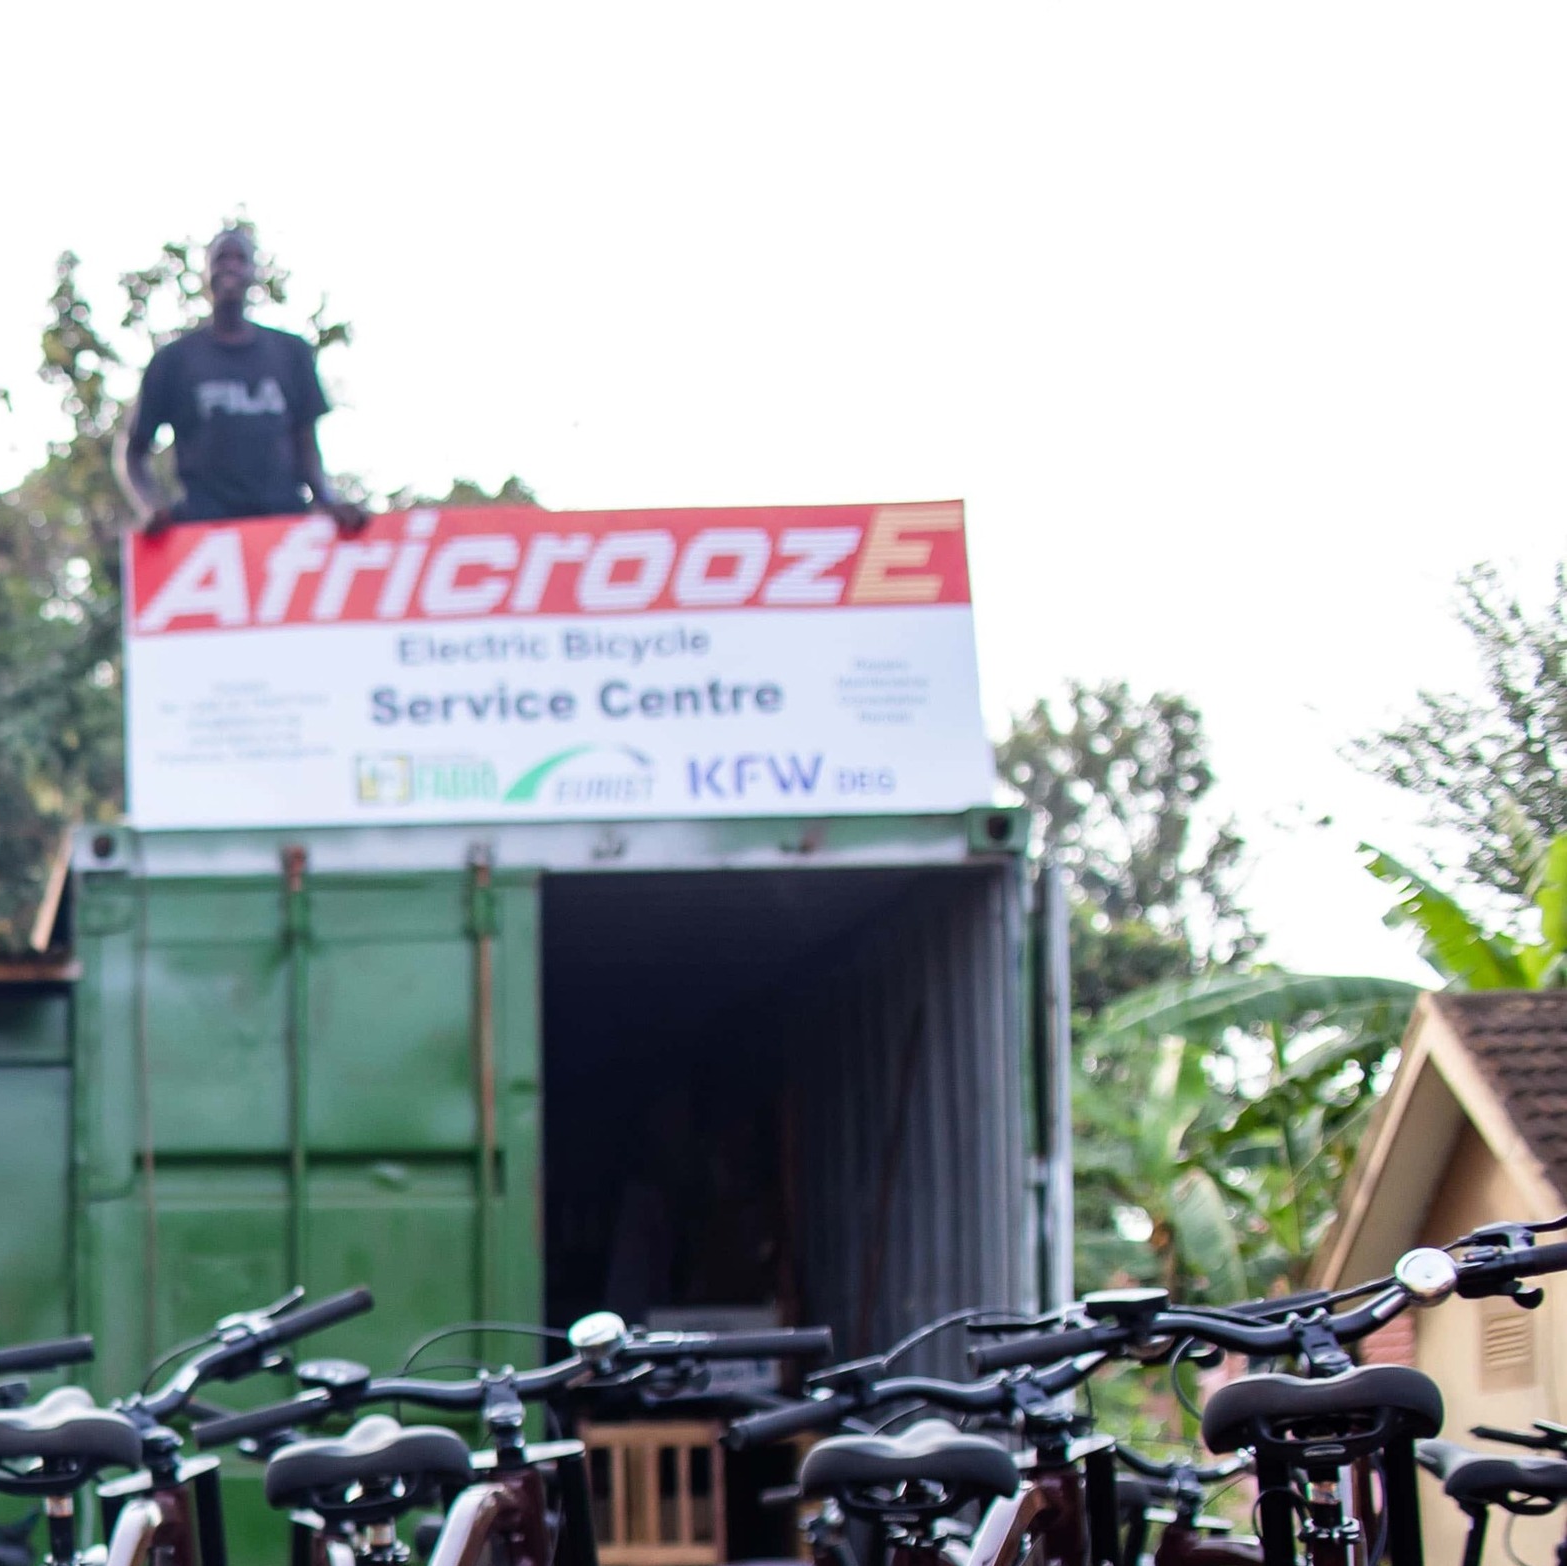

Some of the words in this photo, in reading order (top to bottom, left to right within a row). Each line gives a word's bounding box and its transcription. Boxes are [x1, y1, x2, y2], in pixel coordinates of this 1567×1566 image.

[137, 503, 964, 632] AfricroozE
[397, 628, 549, 668] Electric
[564, 624, 710, 666] Bicycle
[370, 686, 577, 727] Service
[598, 677, 784, 719] Centre
